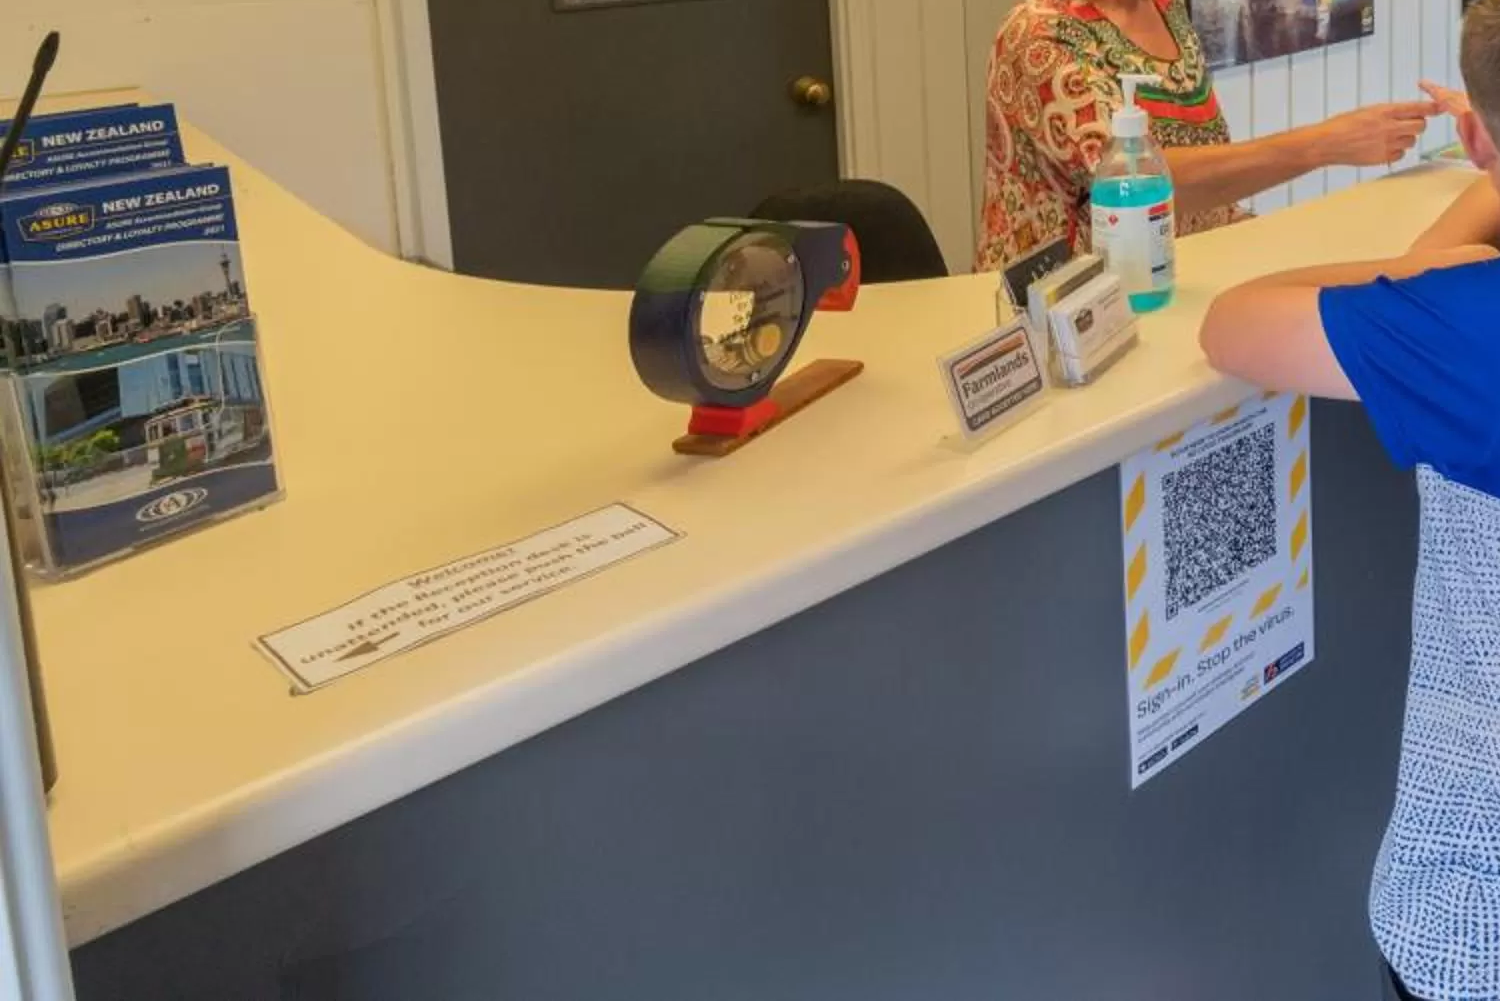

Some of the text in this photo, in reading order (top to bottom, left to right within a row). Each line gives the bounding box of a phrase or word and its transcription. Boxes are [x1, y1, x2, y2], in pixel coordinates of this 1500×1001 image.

[42, 120, 165, 148] NEW ZEALAND
[102, 196, 141, 214] NEW
[144, 184, 220, 206] ZEALAND
[30, 213, 88, 232] ASURE
[56, 234, 112, 252] DIRECTORY
[123, 225, 164, 239] LOYALTY
[962, 350, 1029, 399] Farmlands
[451, 572, 520, 603] please
[575, 538, 609, 554] the
[610, 522, 648, 540] bell
[370, 600, 409, 620] the
[414, 559, 522, 601] Reception
[417, 612, 450, 628] for
[457, 596, 493, 614] our
[1137, 673, 1195, 720] Sign-in.
[1196, 646, 1231, 677] Stop
[1233, 628, 1257, 651] the
[1258, 605, 1295, 636] virus.
